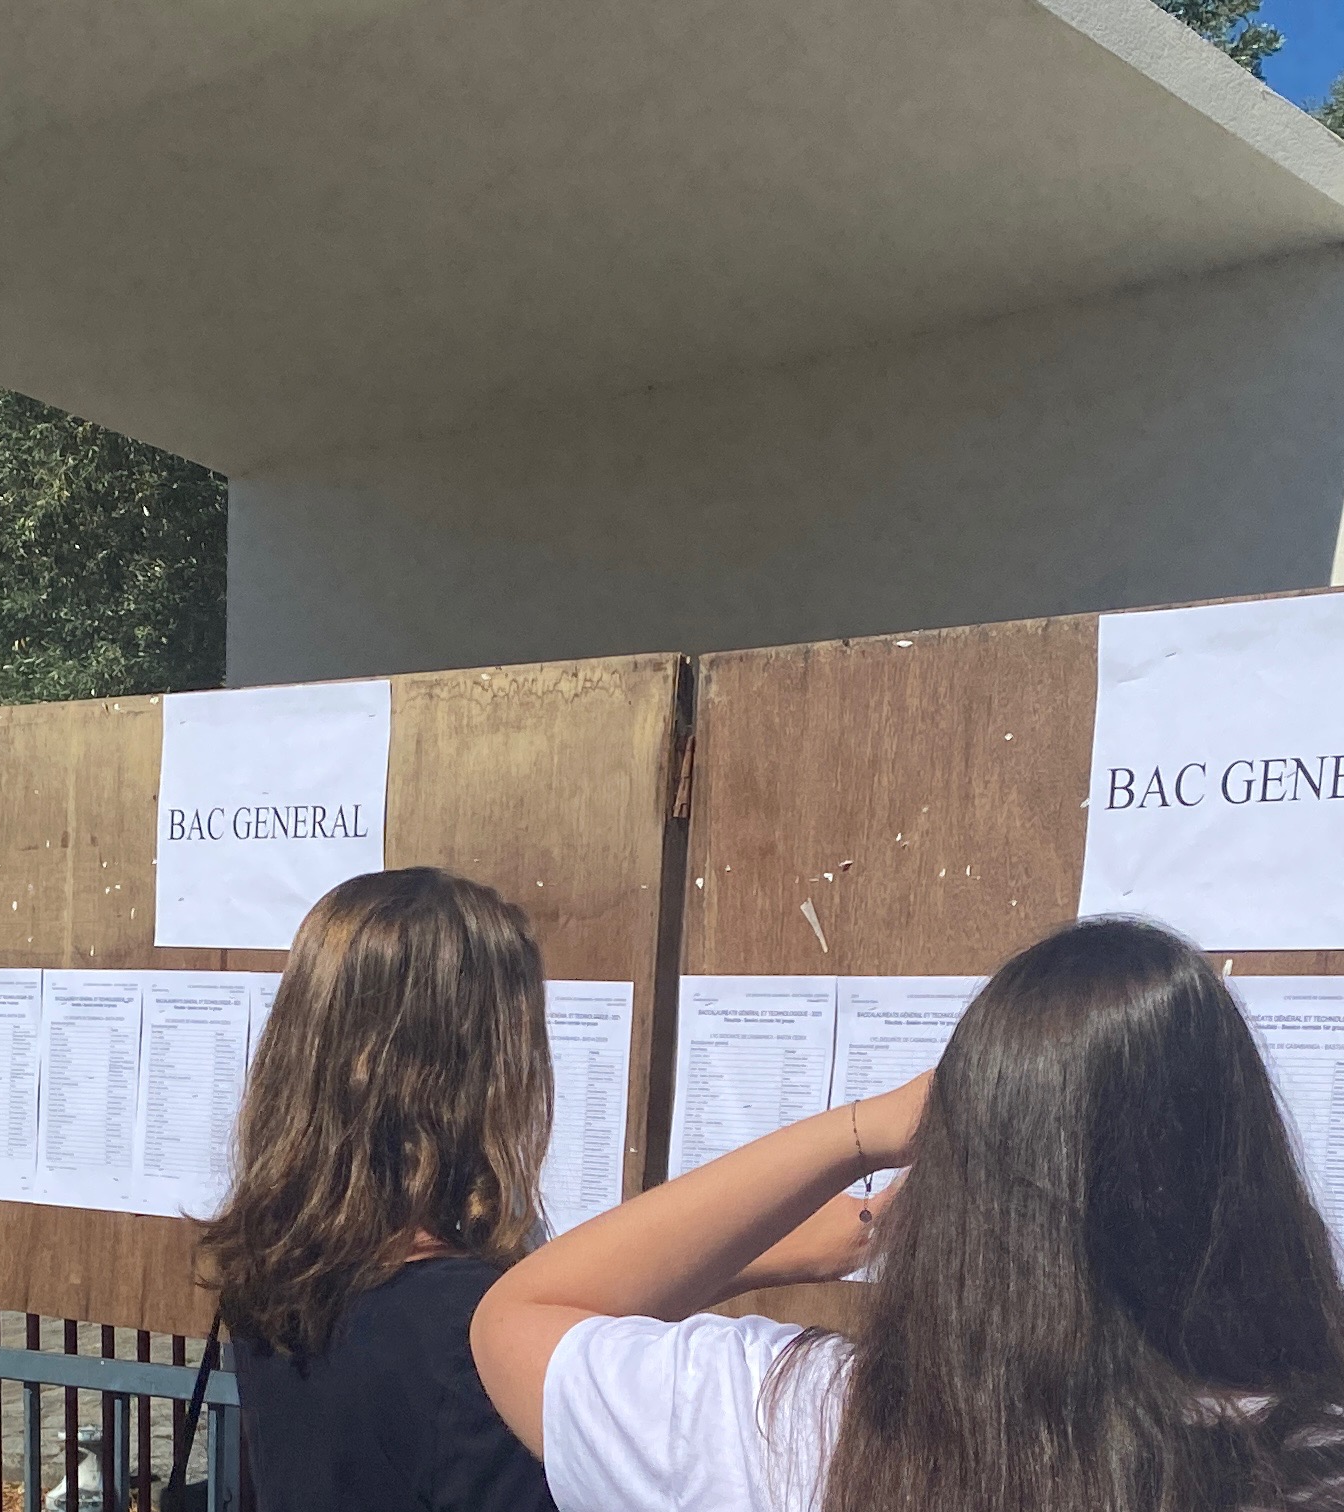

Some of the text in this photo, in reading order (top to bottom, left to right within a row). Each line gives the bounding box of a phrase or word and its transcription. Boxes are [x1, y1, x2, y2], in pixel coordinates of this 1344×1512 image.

[1104, 760, 1208, 811] BAC
[167, 804, 369, 841] BAC GENERAL
